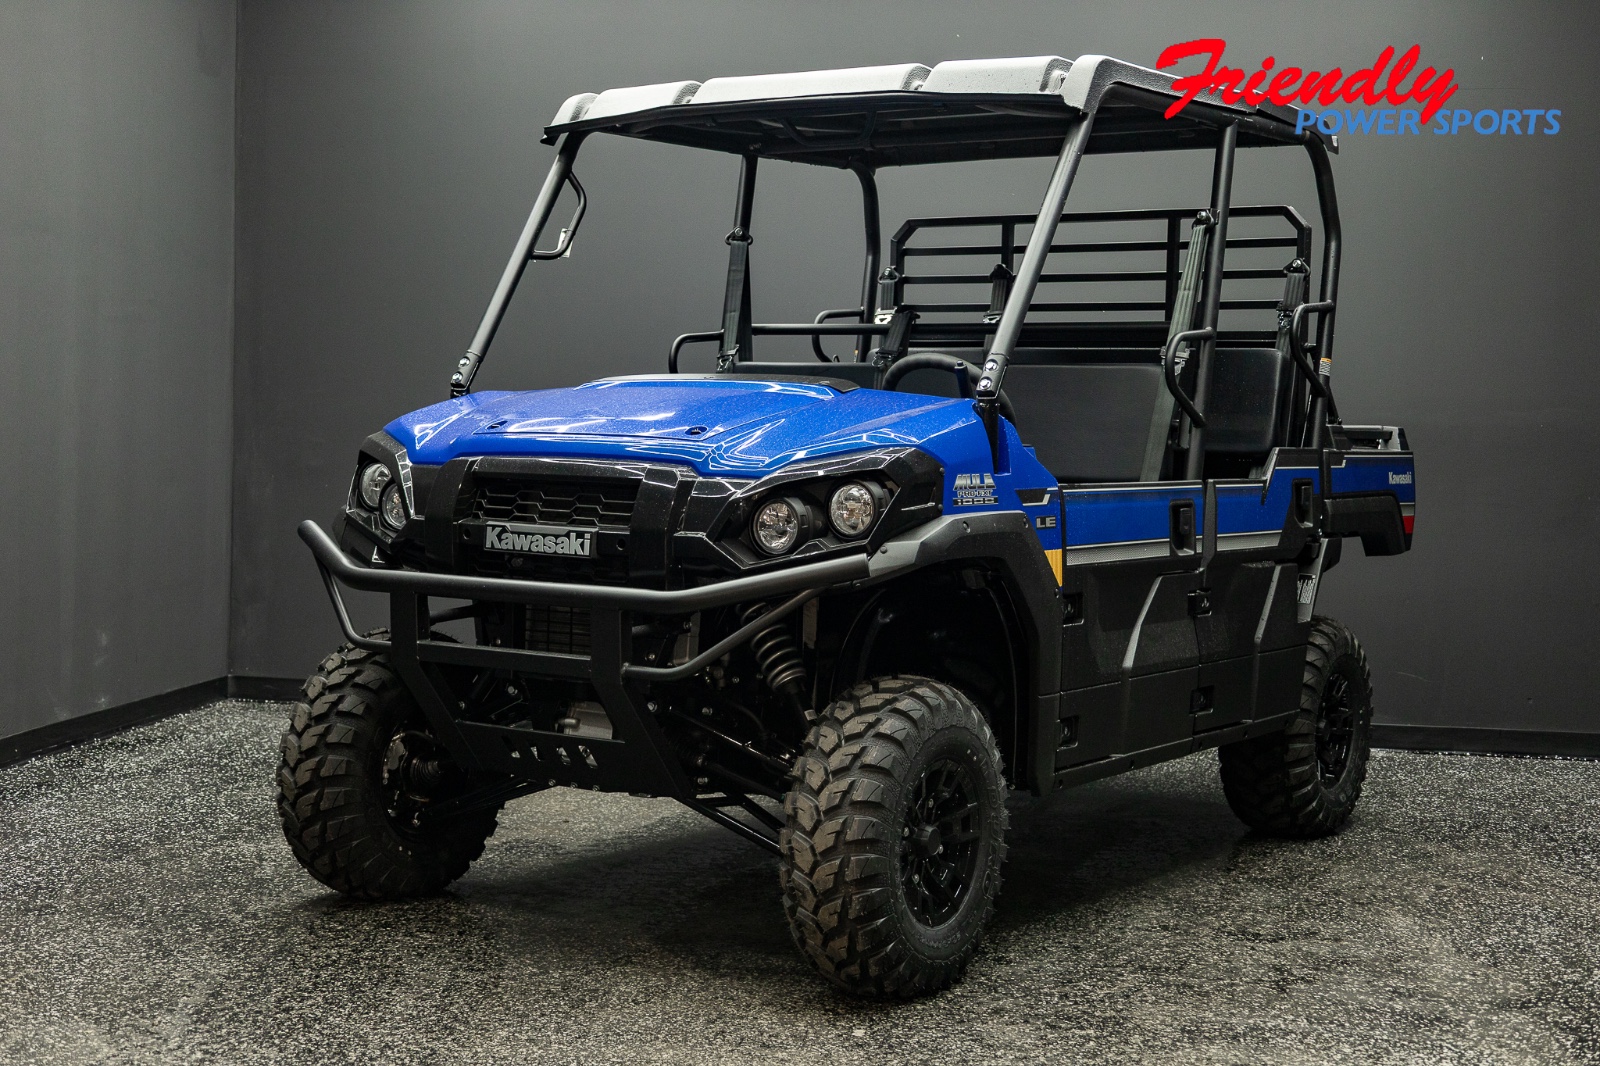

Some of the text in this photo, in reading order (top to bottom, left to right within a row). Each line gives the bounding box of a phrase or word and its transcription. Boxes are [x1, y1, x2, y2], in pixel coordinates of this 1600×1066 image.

[953, 473, 996, 490] MULE
[1388, 471, 1412, 484] Kawasaki
[1036, 516, 1056, 528] LE
[485, 526, 591, 556] Kawasaki
